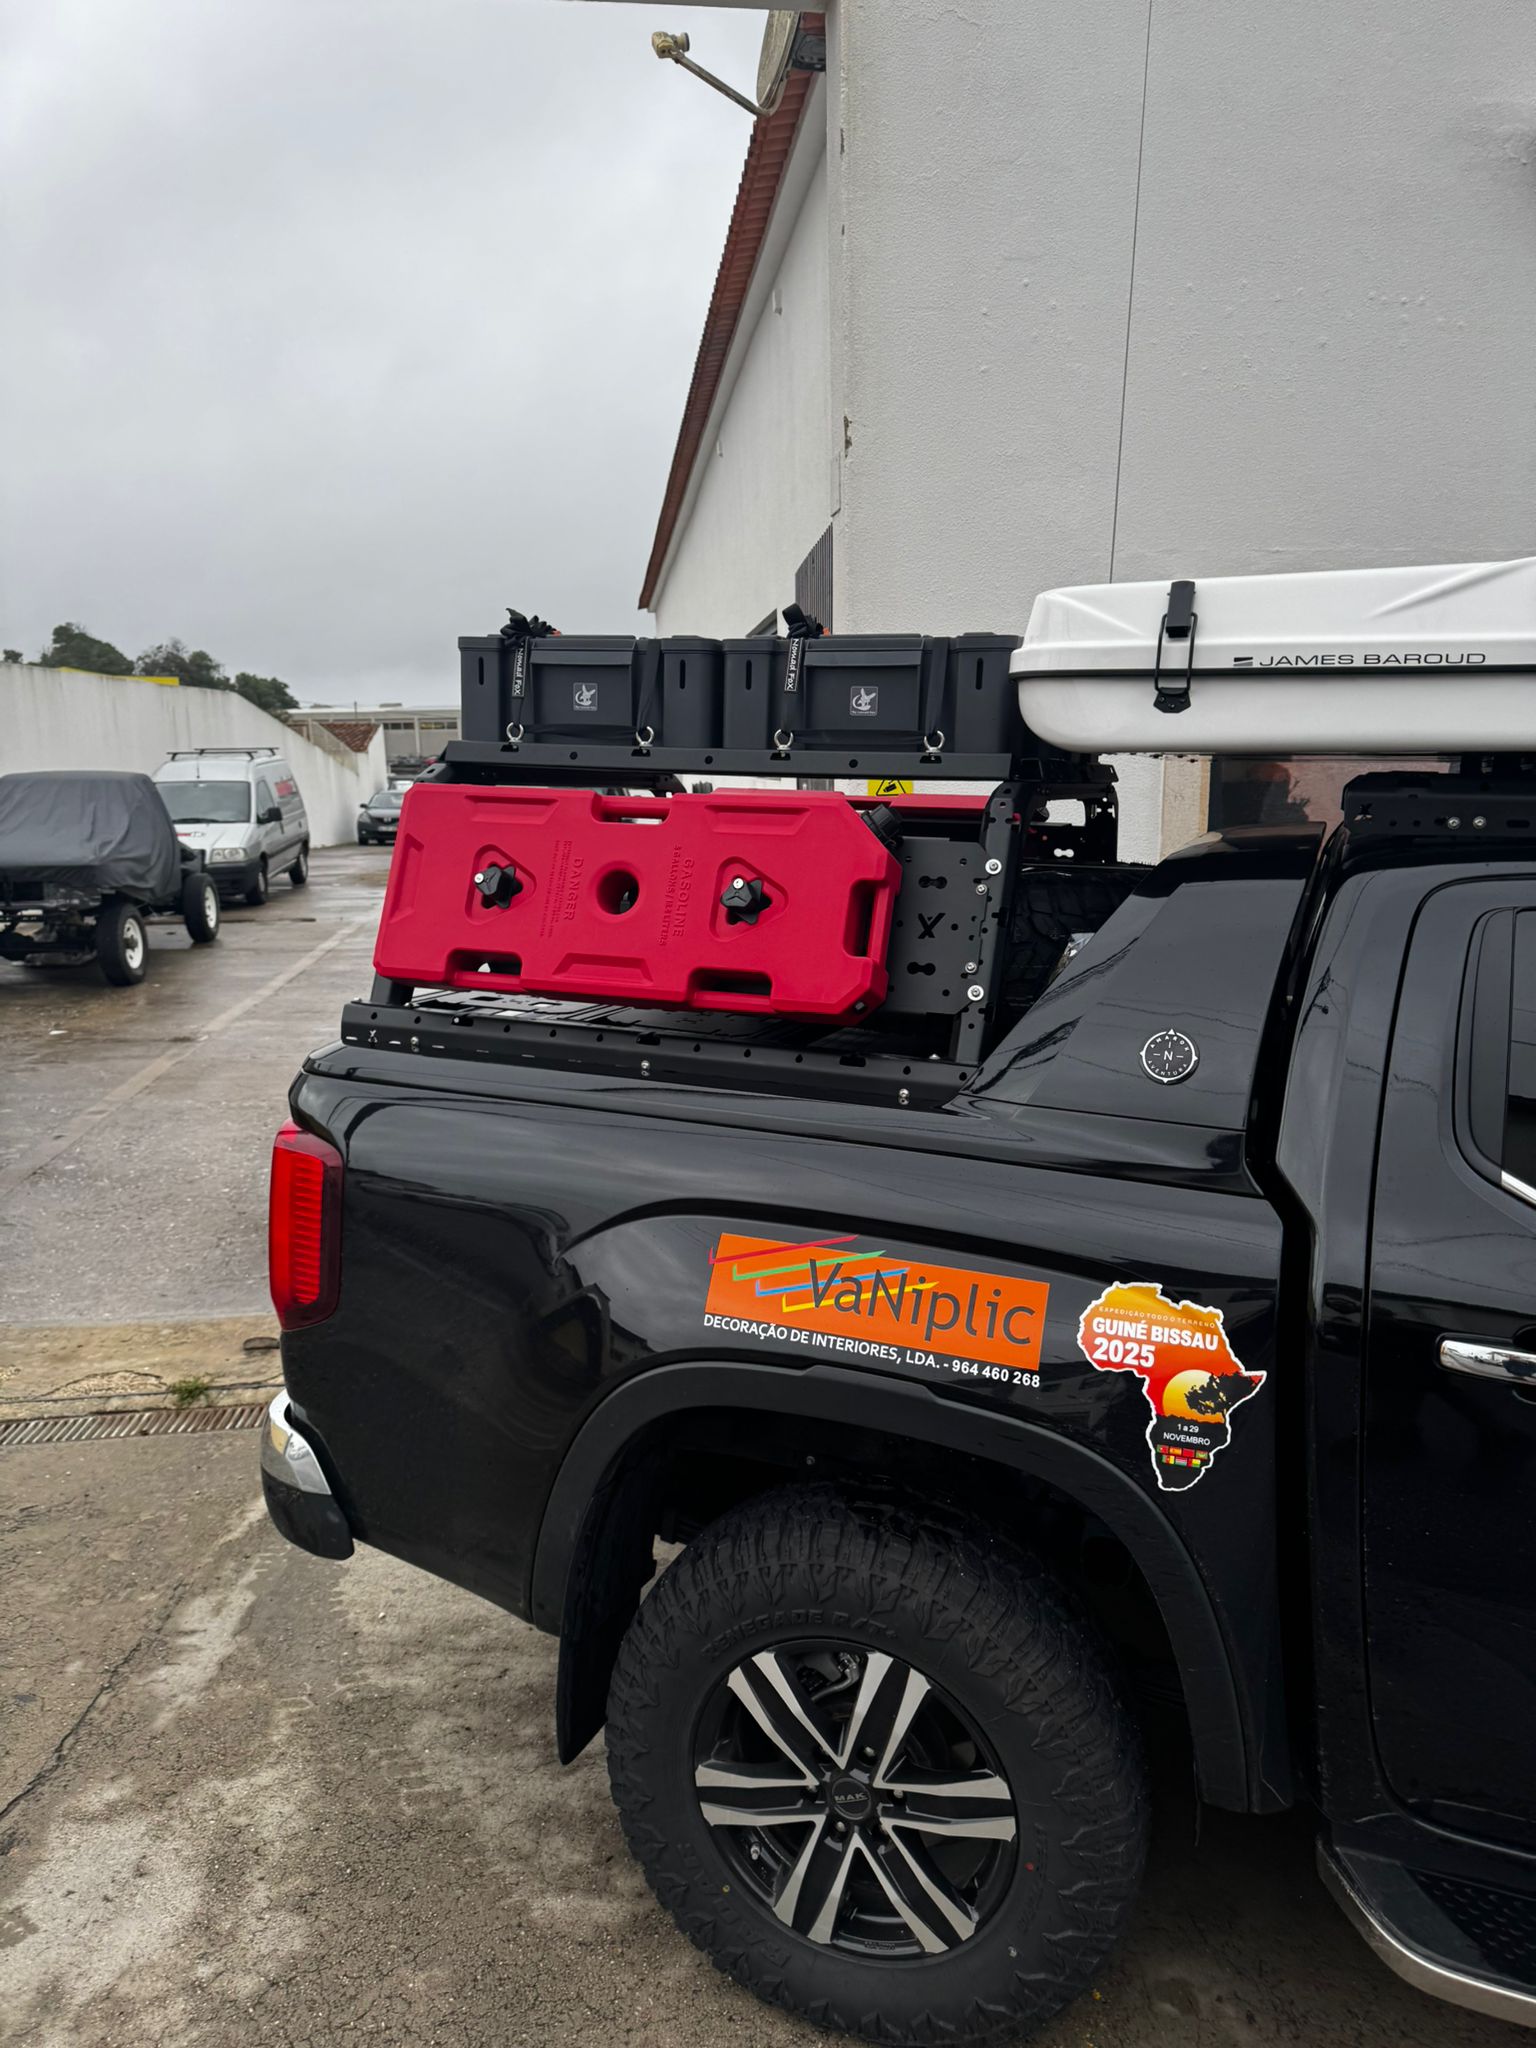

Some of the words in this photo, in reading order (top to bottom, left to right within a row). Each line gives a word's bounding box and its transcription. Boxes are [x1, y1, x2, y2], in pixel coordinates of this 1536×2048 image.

[789, 638, 799, 670] Nomad
[1260, 654, 1354, 667] JAMES
[1363, 653, 1486, 665] BAROUD
[563, 857, 584, 921] DANGER
[672, 857, 695, 937] GASOLINE
[1163, 1050, 1173, 1061] N
[809, 1258, 1036, 1345] VaNiplic
[1098, 1305, 1145, 1319] EXPEDIÇÃO
[1146, 1313, 1168, 1321] TODO
[1092, 1317, 1148, 1340] GUINÉ
[1150, 1325, 1219, 1351] BISSAU
[703, 1314, 788, 1340] DECORAÇÃO
[790, 1329, 810, 1344] DE
[811, 1332, 901, 1364] INTERIORES,
[905, 1350, 940, 1369] LDA.
[952, 1360, 979, 1376] 964
[981, 1367, 1009, 1382] 460
[1012, 1371, 1041, 1388] 268
[1092, 1337, 1155, 1368] 2025
[1163, 1432, 1211, 1446] NOVEMBRO
[1177, 1423, 1182, 1431] 1
[1189, 1425, 1199, 1433] 29
[833, 1792, 867, 1802] MAK
